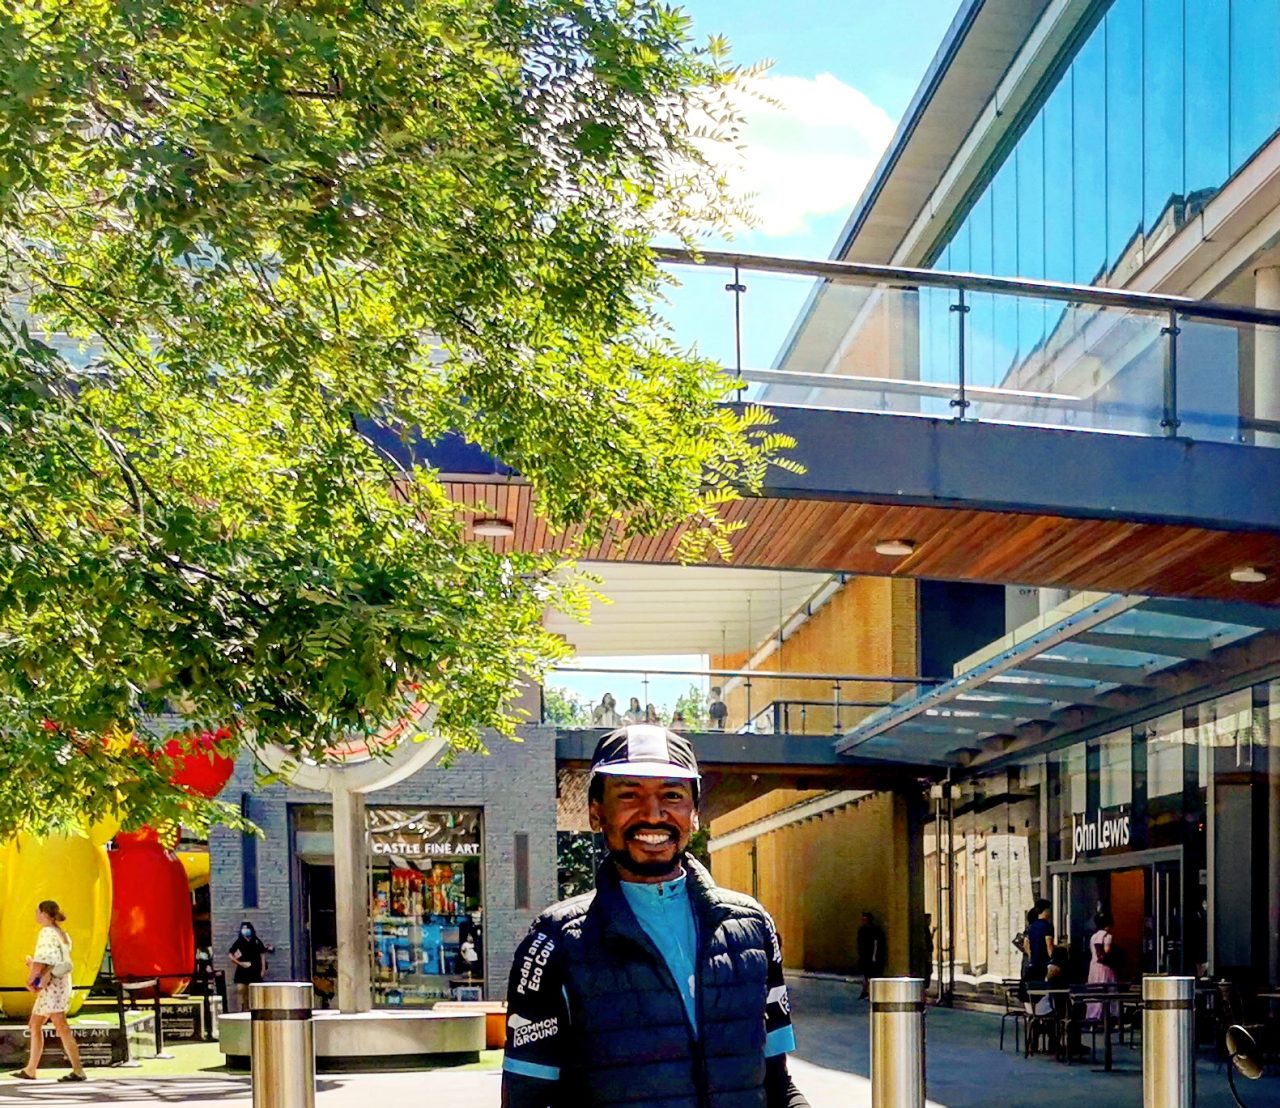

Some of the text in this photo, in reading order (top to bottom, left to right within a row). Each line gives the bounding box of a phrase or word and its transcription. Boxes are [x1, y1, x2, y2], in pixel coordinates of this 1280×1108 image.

[1071, 804, 1130, 865] John Lewis
[372, 842, 480, 855] CASTLE FINE ART
[516, 932, 548, 995] Pedal and
[527, 967, 543, 992] Eco
[90, 1029, 110, 1038] ART
[515, 1016, 558, 1037] COMMON
[515, 1025, 559, 1047] GROUND
